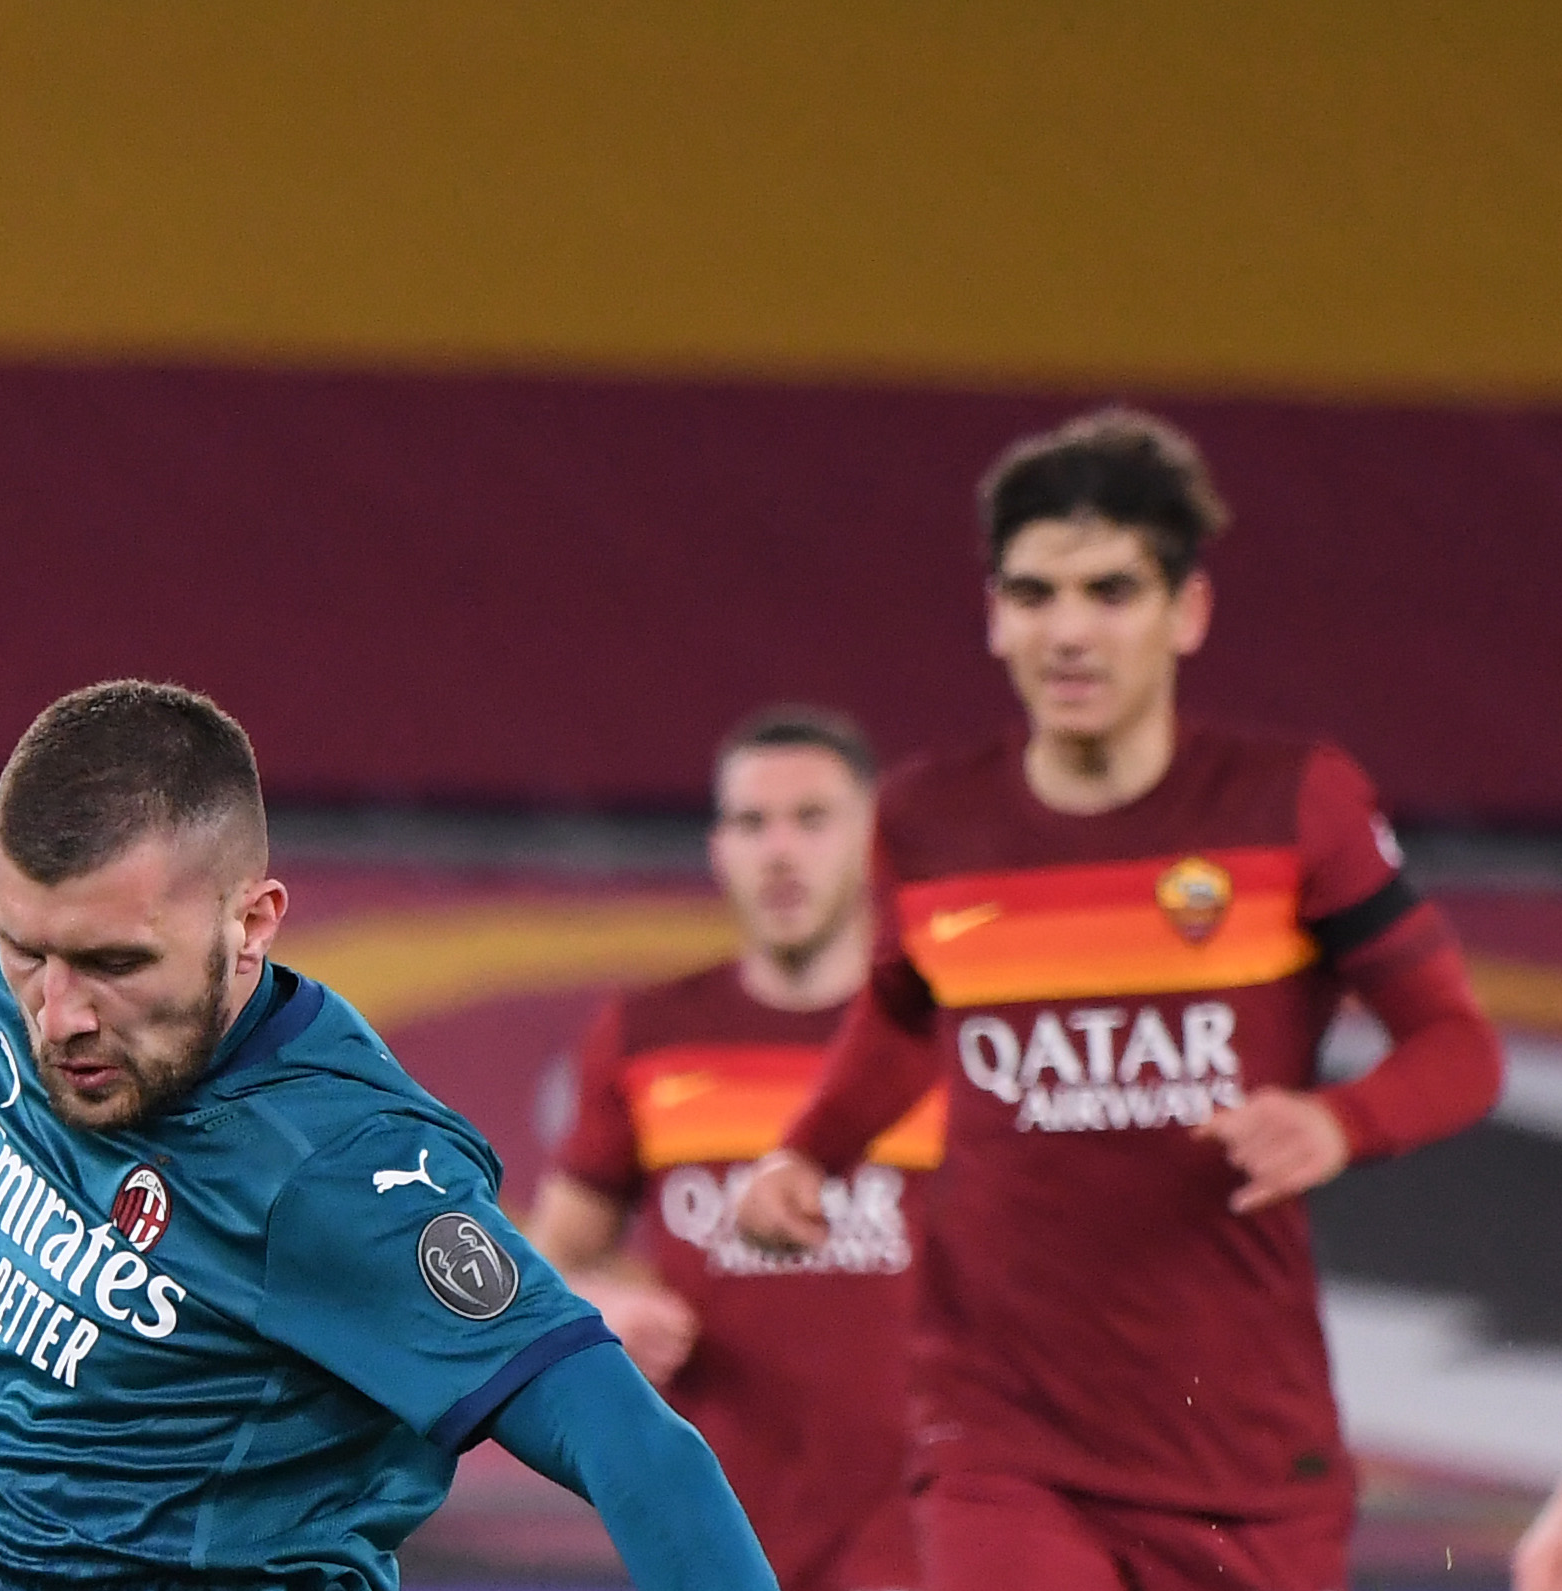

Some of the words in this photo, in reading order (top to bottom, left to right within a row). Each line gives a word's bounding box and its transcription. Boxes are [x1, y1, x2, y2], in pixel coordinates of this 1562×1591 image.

[958, 1002, 1238, 1104] QATAR
[134, 1173, 164, 1200] ACM
[461, 1259, 484, 1288] 7
